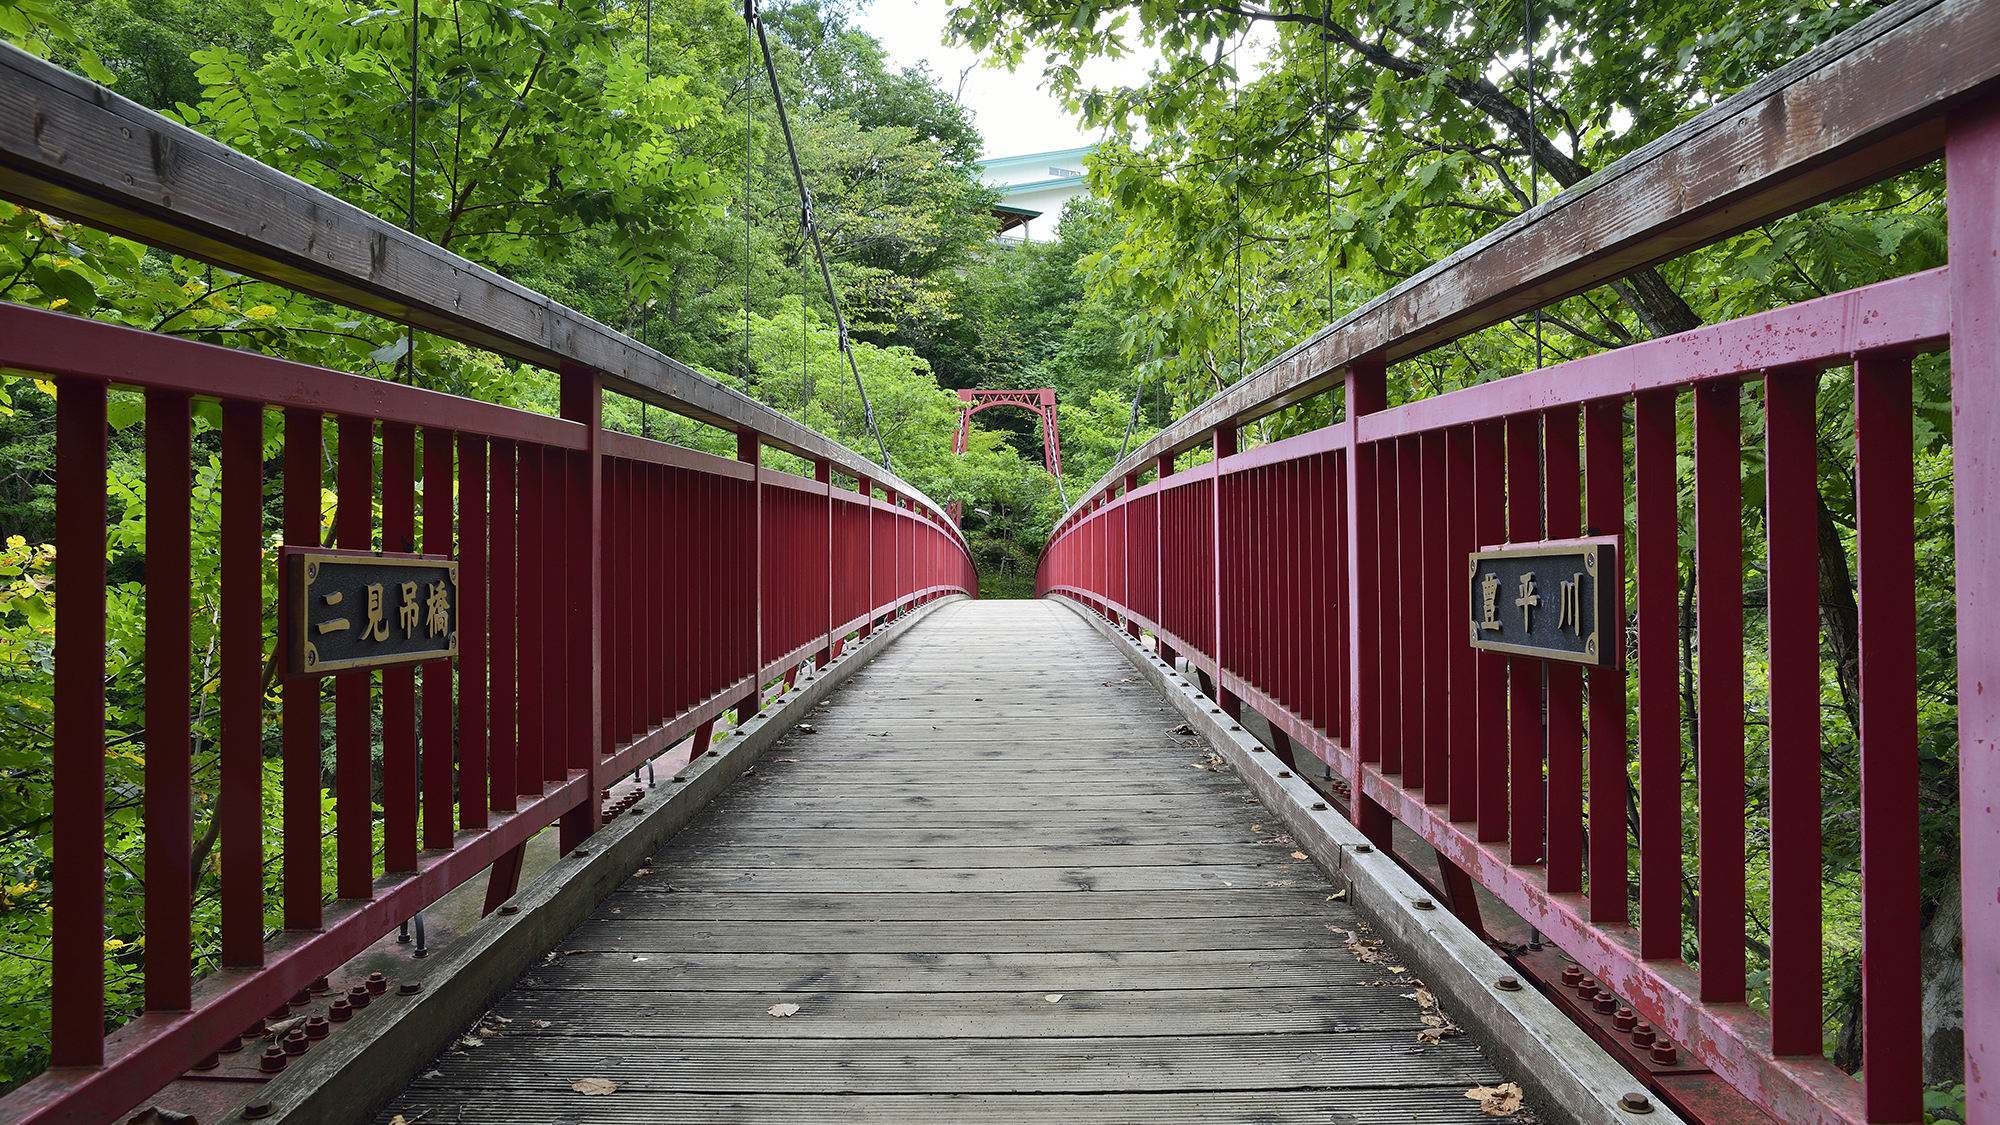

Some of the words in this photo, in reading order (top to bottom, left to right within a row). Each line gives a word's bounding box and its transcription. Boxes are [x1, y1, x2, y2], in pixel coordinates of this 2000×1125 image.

[316, 580, 450, 642] 二見吊橋
[1481, 572, 1582, 638] 豊平川
